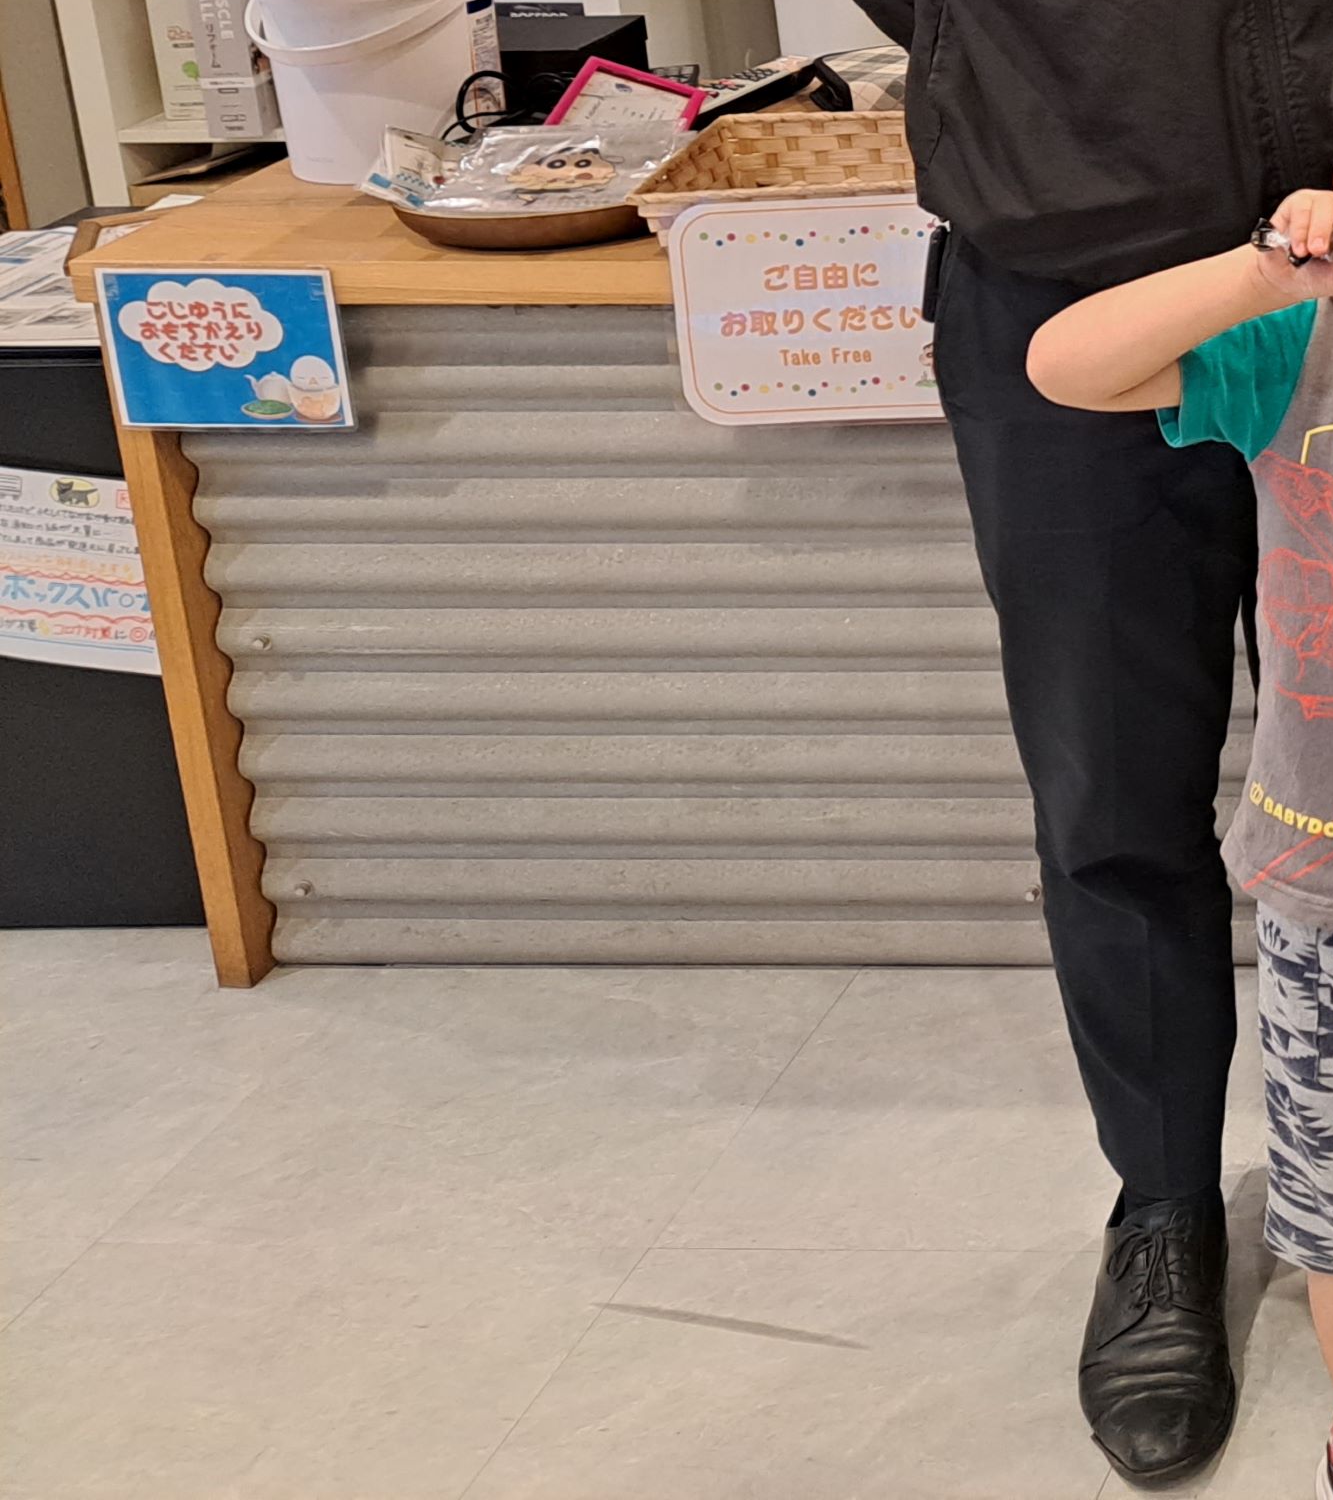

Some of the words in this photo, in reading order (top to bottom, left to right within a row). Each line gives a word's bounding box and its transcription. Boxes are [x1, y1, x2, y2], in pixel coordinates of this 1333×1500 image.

[763, 263, 880, 291] ご自由に
[147, 301, 252, 320] ごじゆうに
[720, 305, 923, 337] お取りください
[139, 322, 263, 341] おもちかえり
[158, 341, 240, 362] ください
[780, 349, 822, 366] Take
[831, 348, 873, 364] Free
